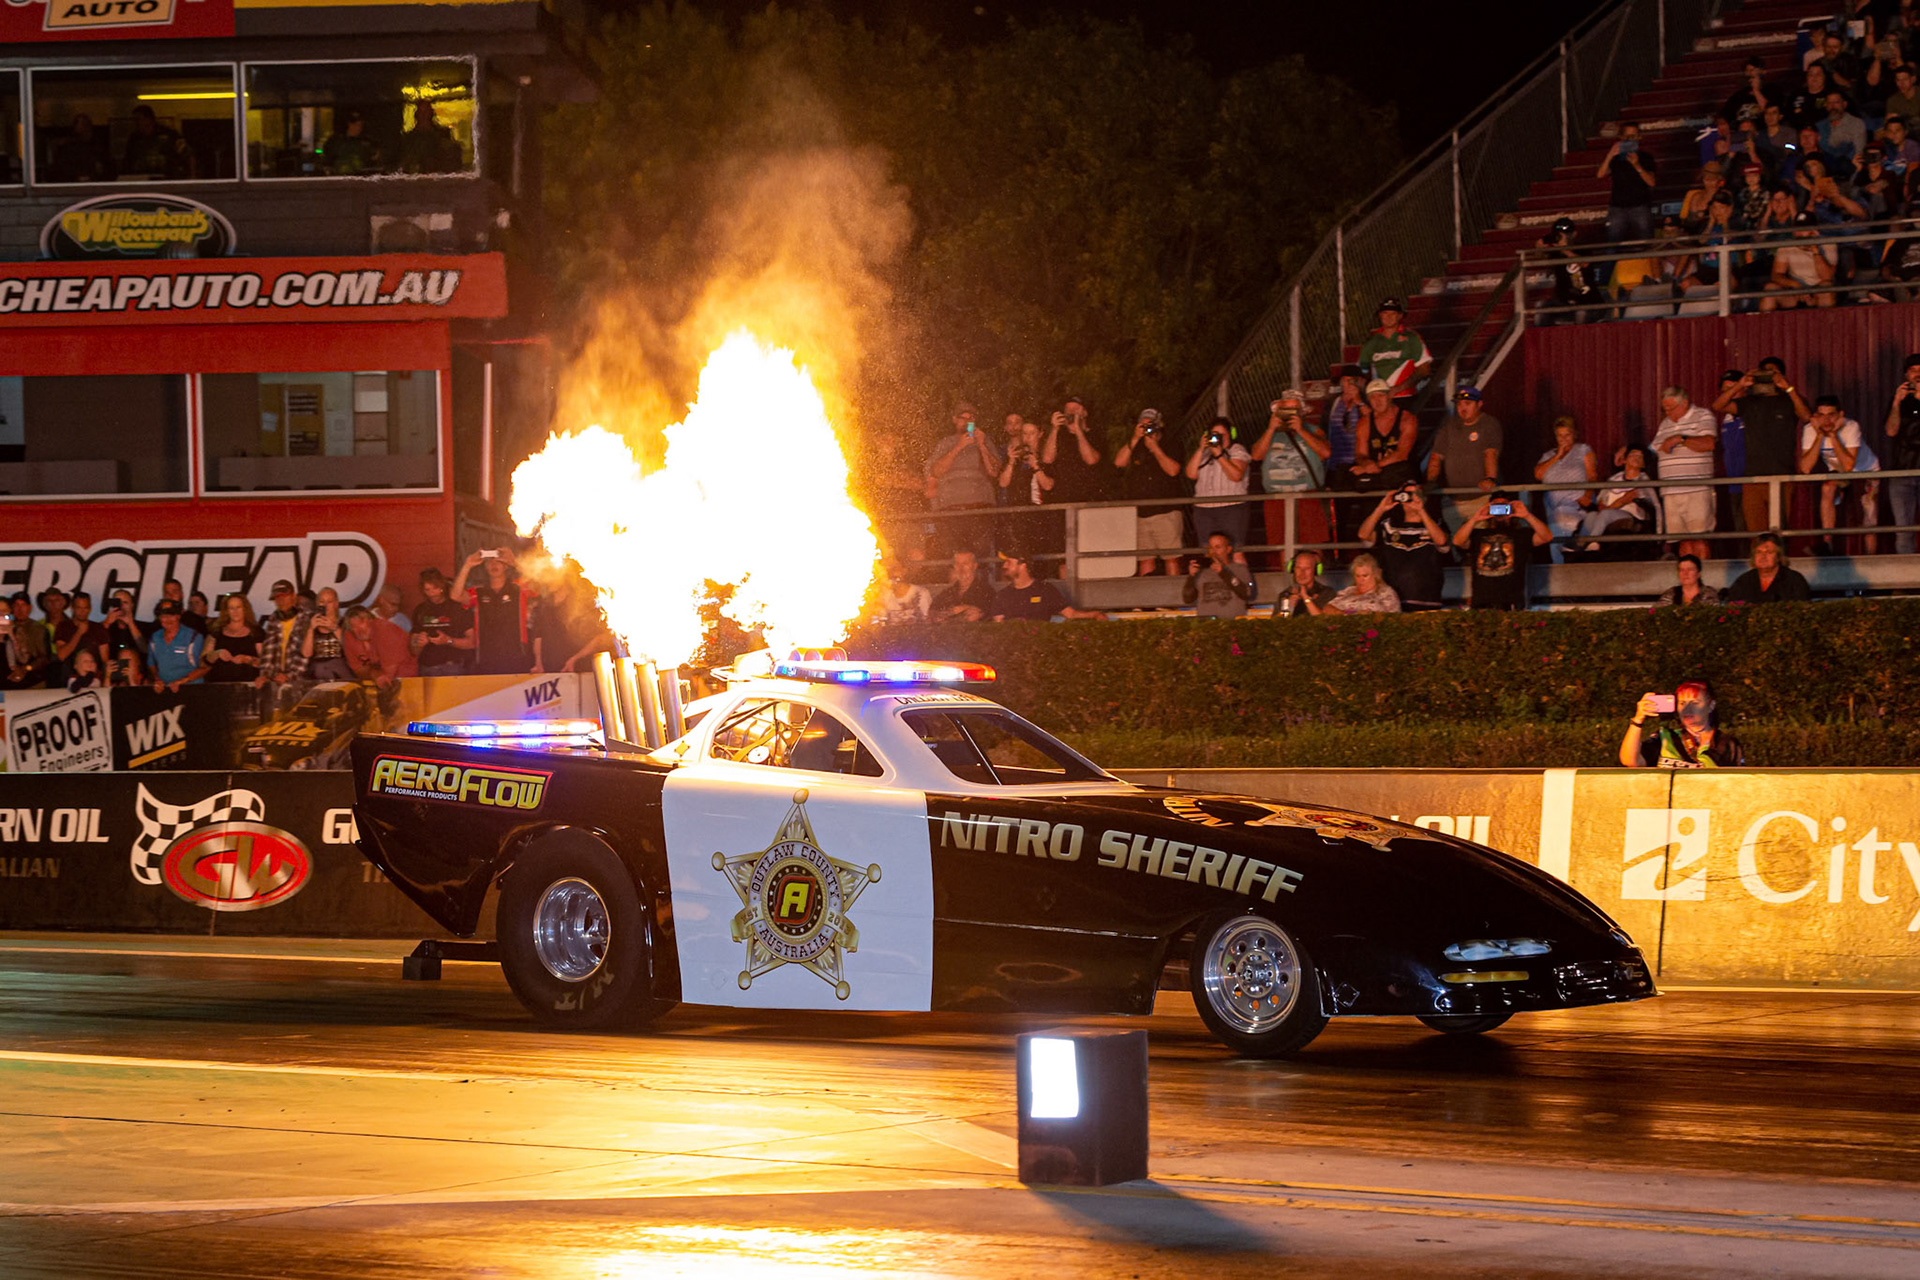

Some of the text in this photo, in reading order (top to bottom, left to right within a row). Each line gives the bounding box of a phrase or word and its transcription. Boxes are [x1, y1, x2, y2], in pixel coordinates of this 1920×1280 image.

[62, 0, 159, 19] AUTO
[63, 209, 208, 242] Willowbank
[525, 678, 562, 708] WIX
[16, 704, 98, 763] PROOF
[125, 704, 187, 756] WIX
[38, 745, 105, 772] Engineers
[372, 758, 546, 809] AEROFLOW
[384, 785, 458, 802] PERFORMANCE PRODUCTS
[50, 808, 110, 843] OIL
[751, 843, 841, 900] OUTLAW COUNTY
[940, 810, 1305, 904] NITRO SHERIFF
[758, 927, 830, 961] AUSTRALIA
